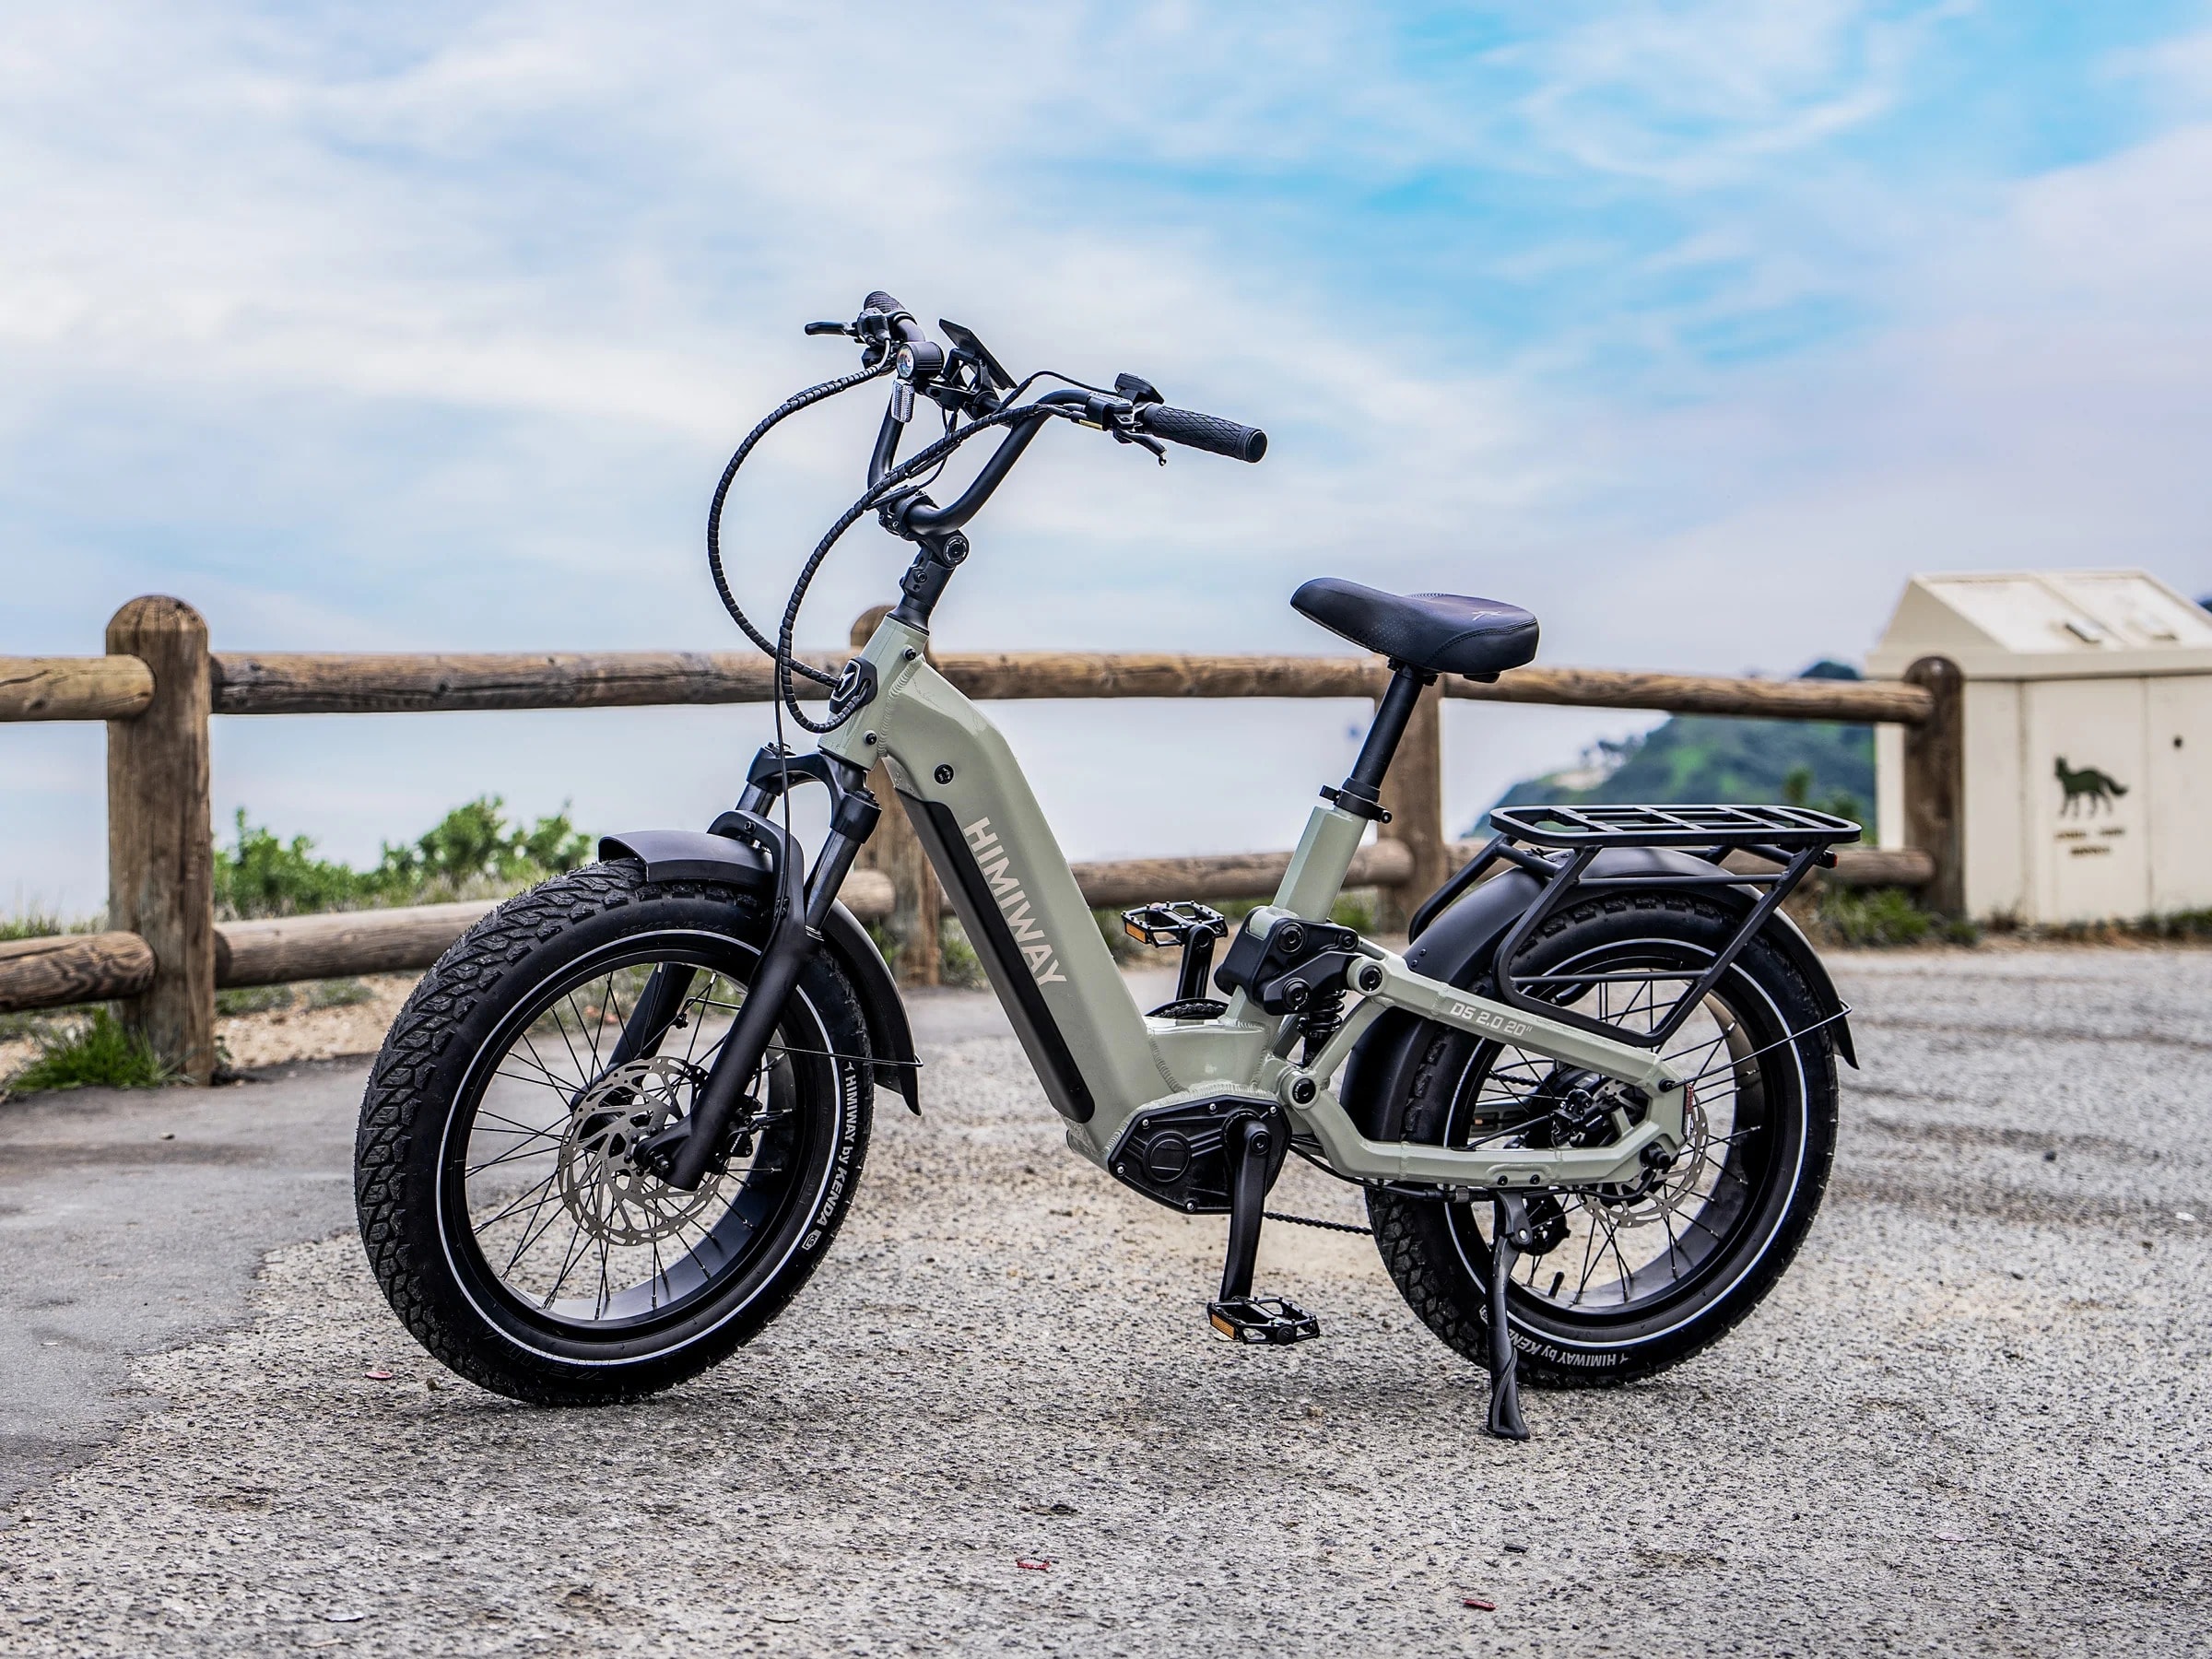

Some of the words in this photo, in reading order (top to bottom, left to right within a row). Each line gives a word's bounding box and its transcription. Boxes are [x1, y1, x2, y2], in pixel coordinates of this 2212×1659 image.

[963, 817, 1067, 986] HIMIWAY
[1450, 1002, 1477, 1020] DS
[1476, 1012, 1503, 1030] 2.0
[844, 1075, 858, 1144] HIMIWAY
[838, 1146, 853, 1164] by
[817, 1165, 848, 1227] KENDA
[1541, 1344, 1559, 1361] by
[1558, 1352, 1617, 1367] HIMIWAY
